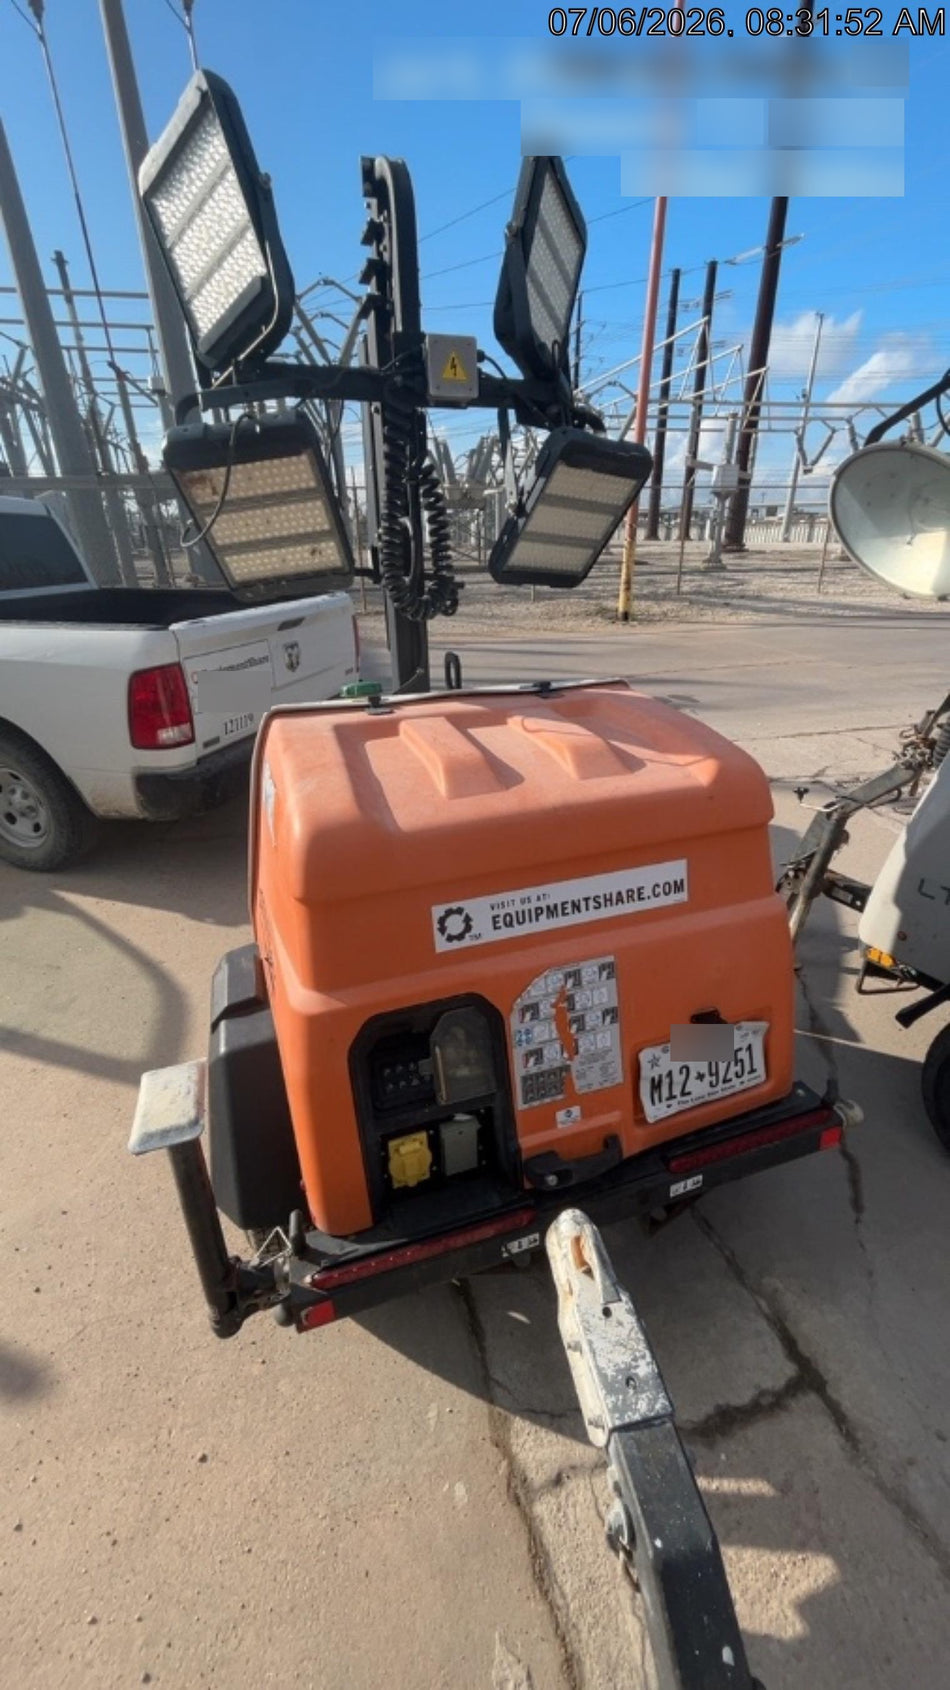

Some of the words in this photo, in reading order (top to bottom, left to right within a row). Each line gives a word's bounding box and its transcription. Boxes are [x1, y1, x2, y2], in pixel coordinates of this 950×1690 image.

[489, 898, 516, 911] VISIT
[520, 896, 532, 905] US
[491, 878, 685, 931] EQUIPMENTSHARE.COM
[650, 1064, 692, 1106] M12
[707, 1043, 757, 1088] 9251
